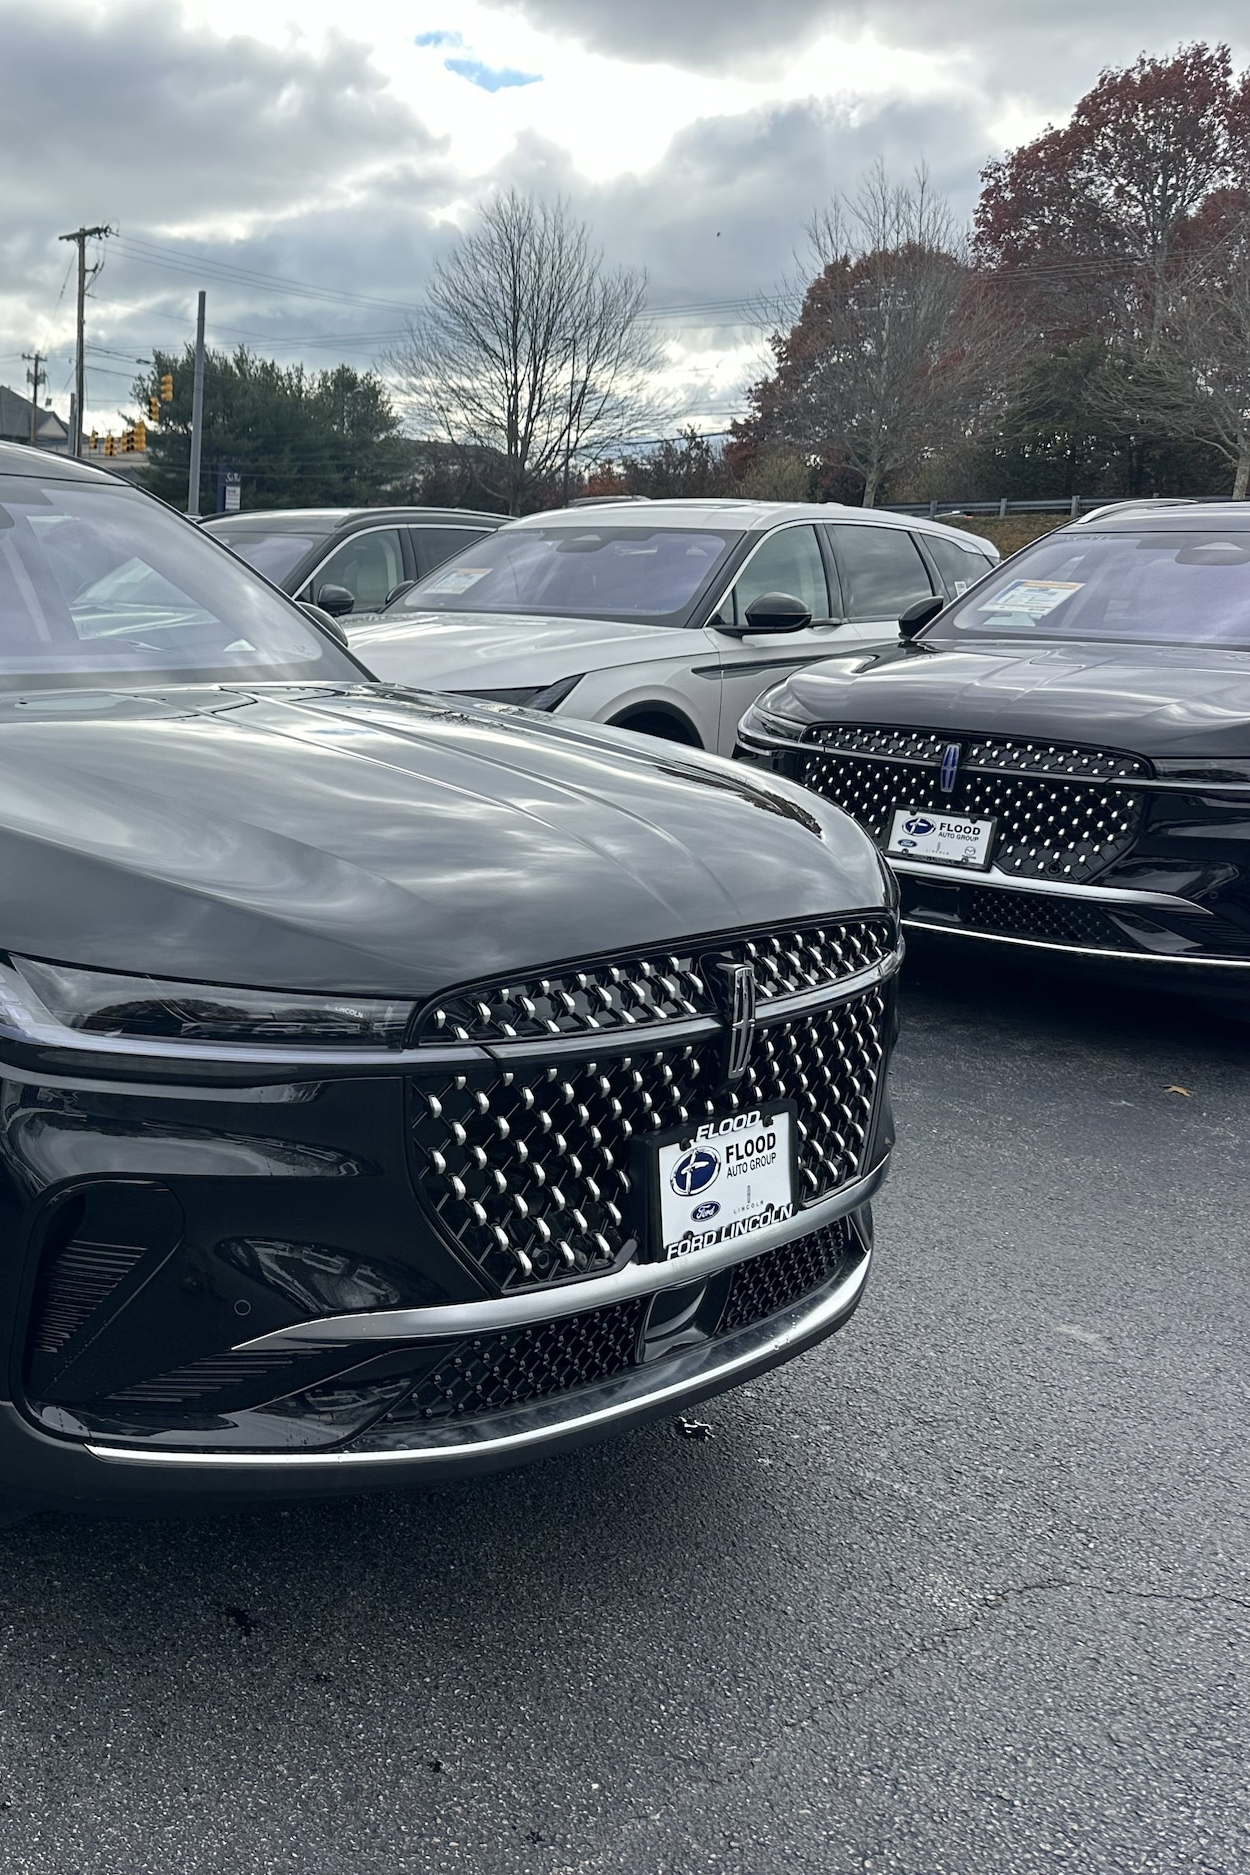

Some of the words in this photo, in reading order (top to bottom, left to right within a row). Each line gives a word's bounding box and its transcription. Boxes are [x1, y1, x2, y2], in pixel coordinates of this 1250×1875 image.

[938, 831, 955, 839] AUTO
[956, 833, 979, 842] GROUP
[939, 822, 981, 836] FLOOD
[334, 1006, 364, 1019] LINCOLN
[696, 1110, 761, 1142] FLOOD
[725, 1133, 777, 1164] FLOOD
[726, 1163, 748, 1179] AUTO
[749, 1152, 777, 1171] GROUP
[696, 1204, 716, 1219] Ford
[733, 1200, 765, 1214] LINCOLN
[667, 1230, 717, 1260] FORD
[720, 1203, 794, 1242] LINCOLN
